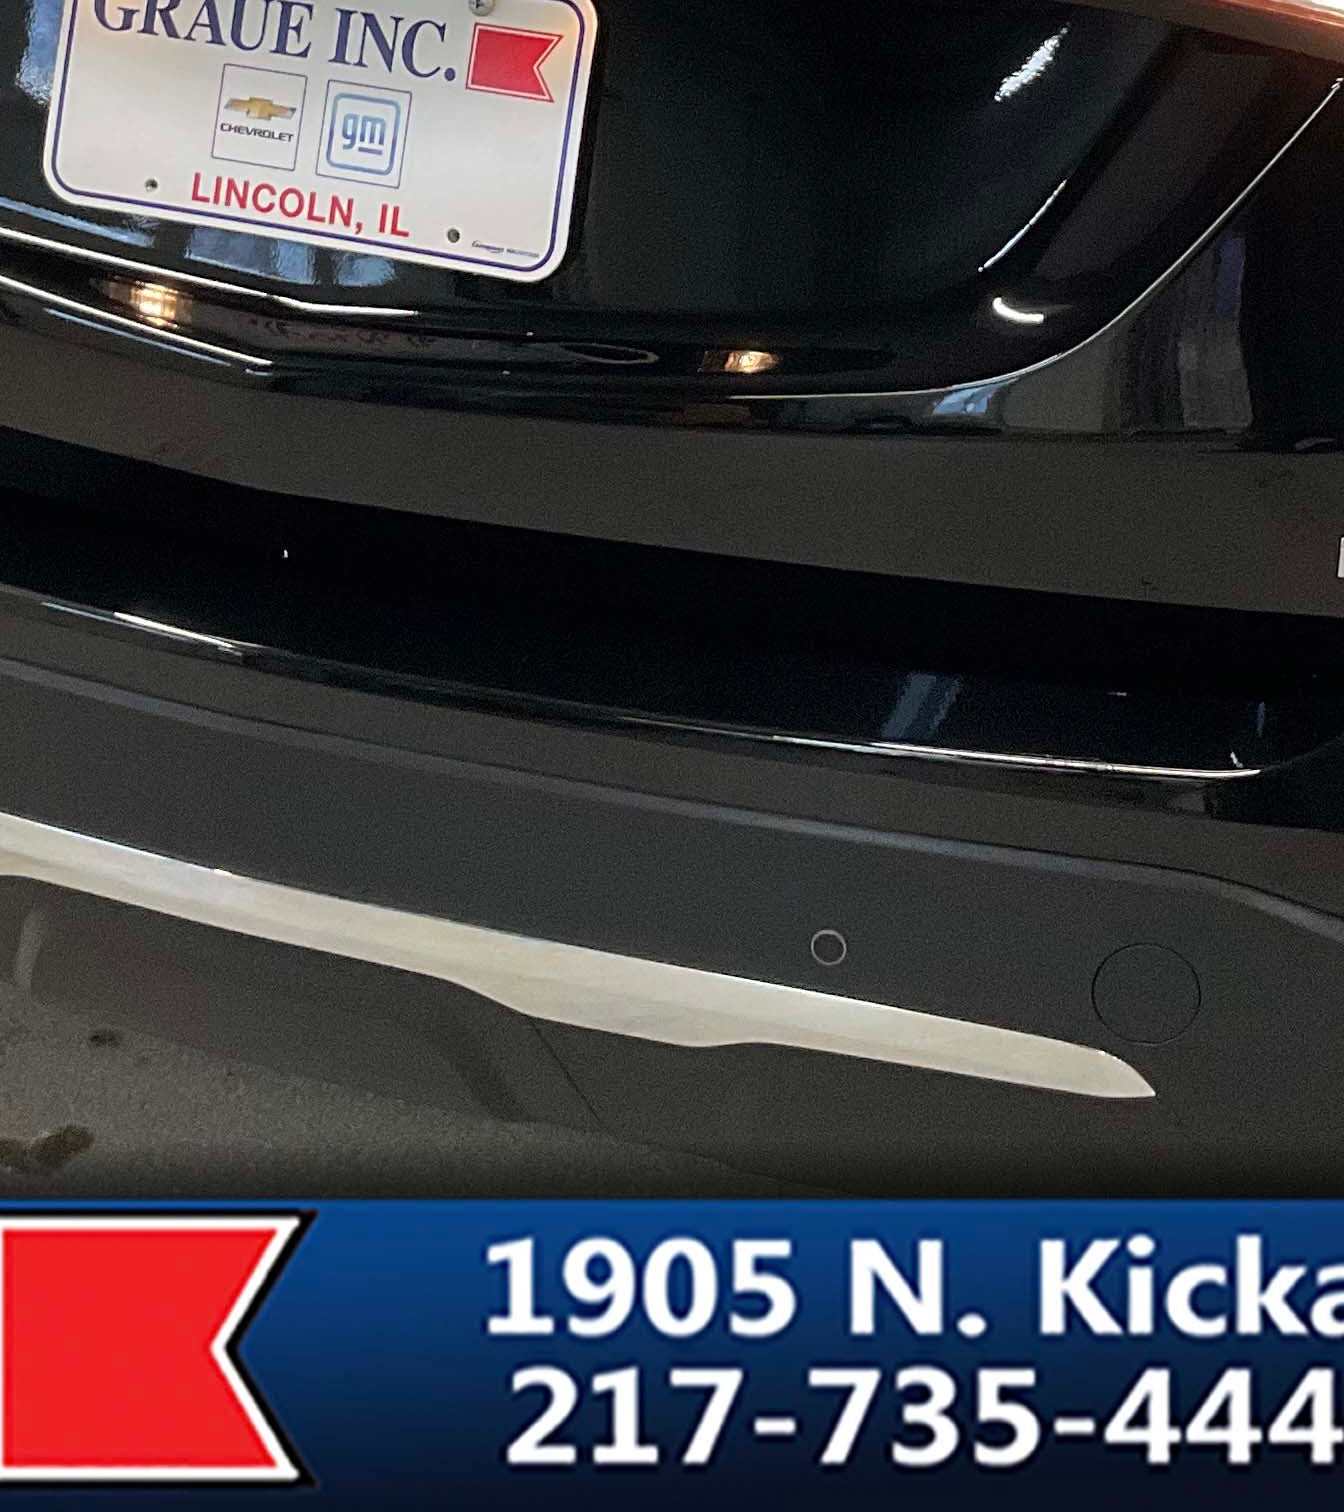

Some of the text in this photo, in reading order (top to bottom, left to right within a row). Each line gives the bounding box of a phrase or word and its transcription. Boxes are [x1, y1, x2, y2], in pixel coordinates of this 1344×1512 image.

[326, 6, 458, 83] INC.
[219, 122, 295, 143] CHEVROLET
[341, 112, 387, 155] gm
[191, 172, 411, 238] LINCOLN, IL
